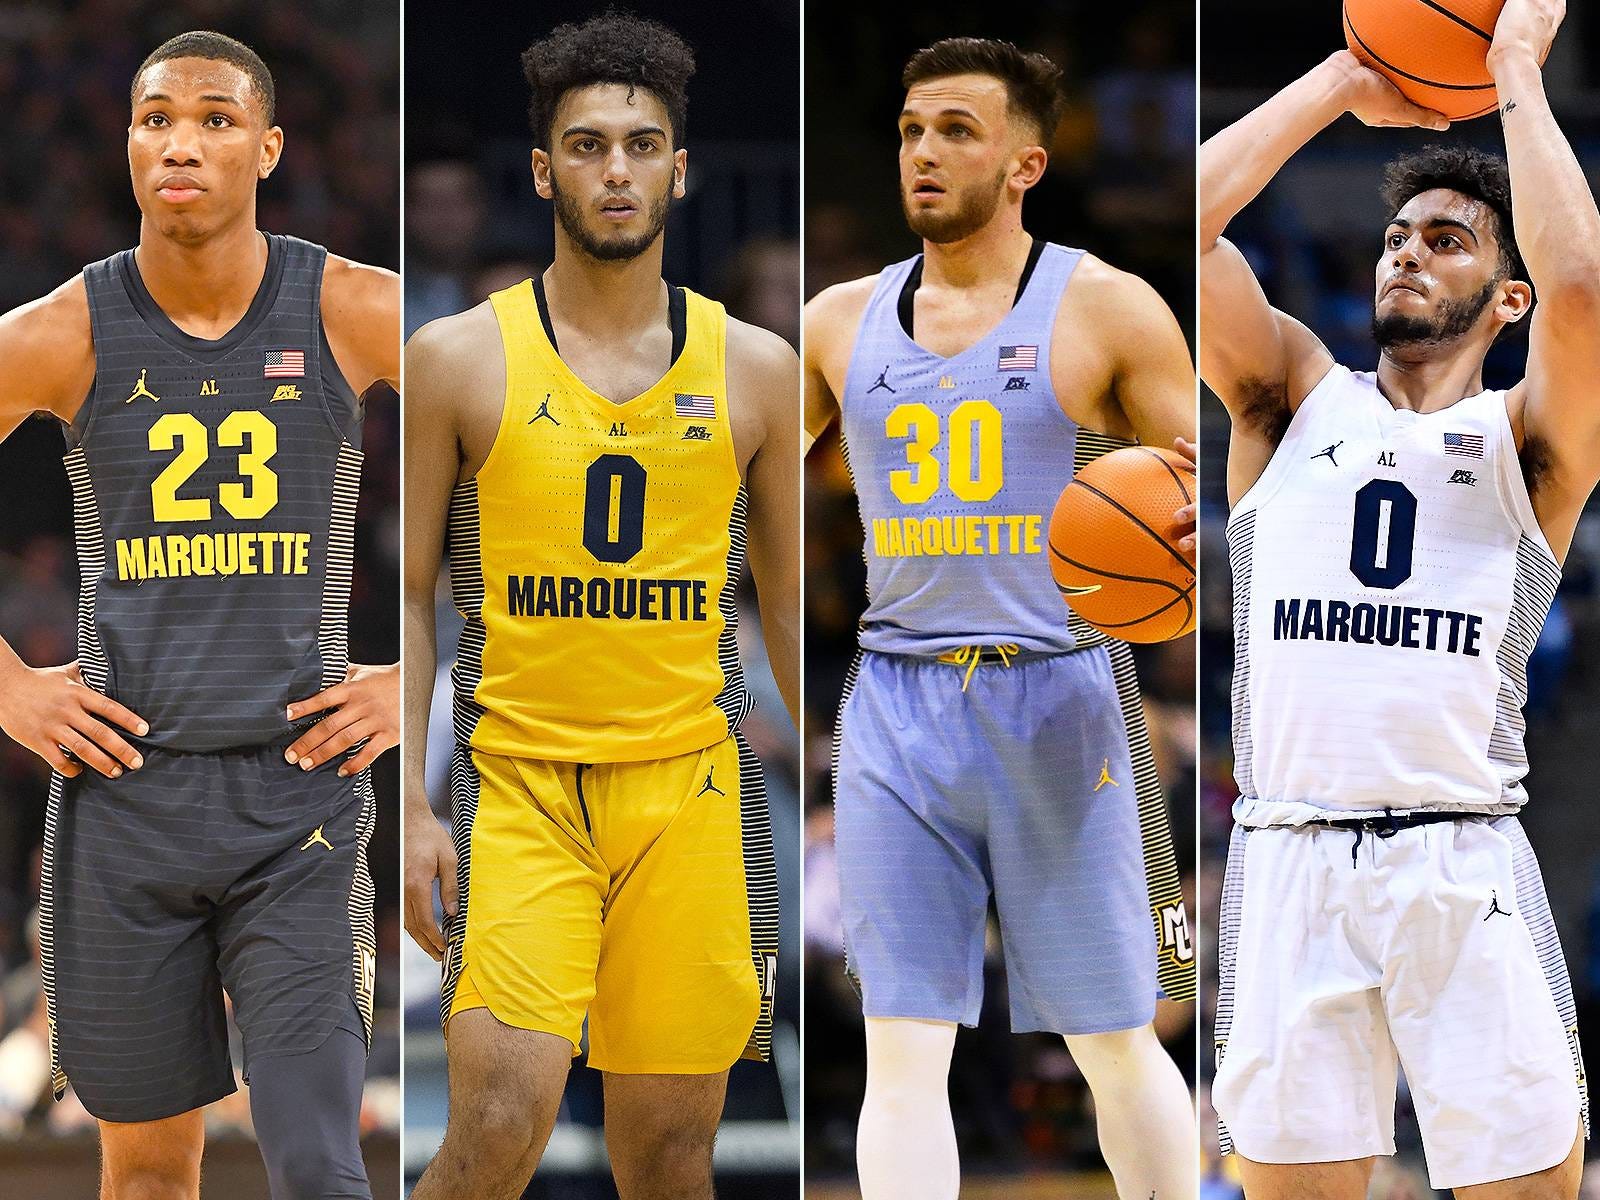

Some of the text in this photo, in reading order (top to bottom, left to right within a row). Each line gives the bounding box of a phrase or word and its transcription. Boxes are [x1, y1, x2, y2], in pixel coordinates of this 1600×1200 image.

[200, 379, 219, 396] AL
[938, 376, 956, 389] AL
[608, 422, 628, 437] AL
[885, 400, 1004, 504] 30
[148, 411, 279, 522] 23
[1377, 451, 1396, 467] AL
[582, 453, 647, 564] 0
[116, 533, 311, 581] MARQUETTE
[872, 515, 1042, 557] MARQUETTE
[1350, 478, 1418, 590] 0
[507, 575, 707, 621] MARQUETTE
[1273, 599, 1482, 657] MARQUETTE
